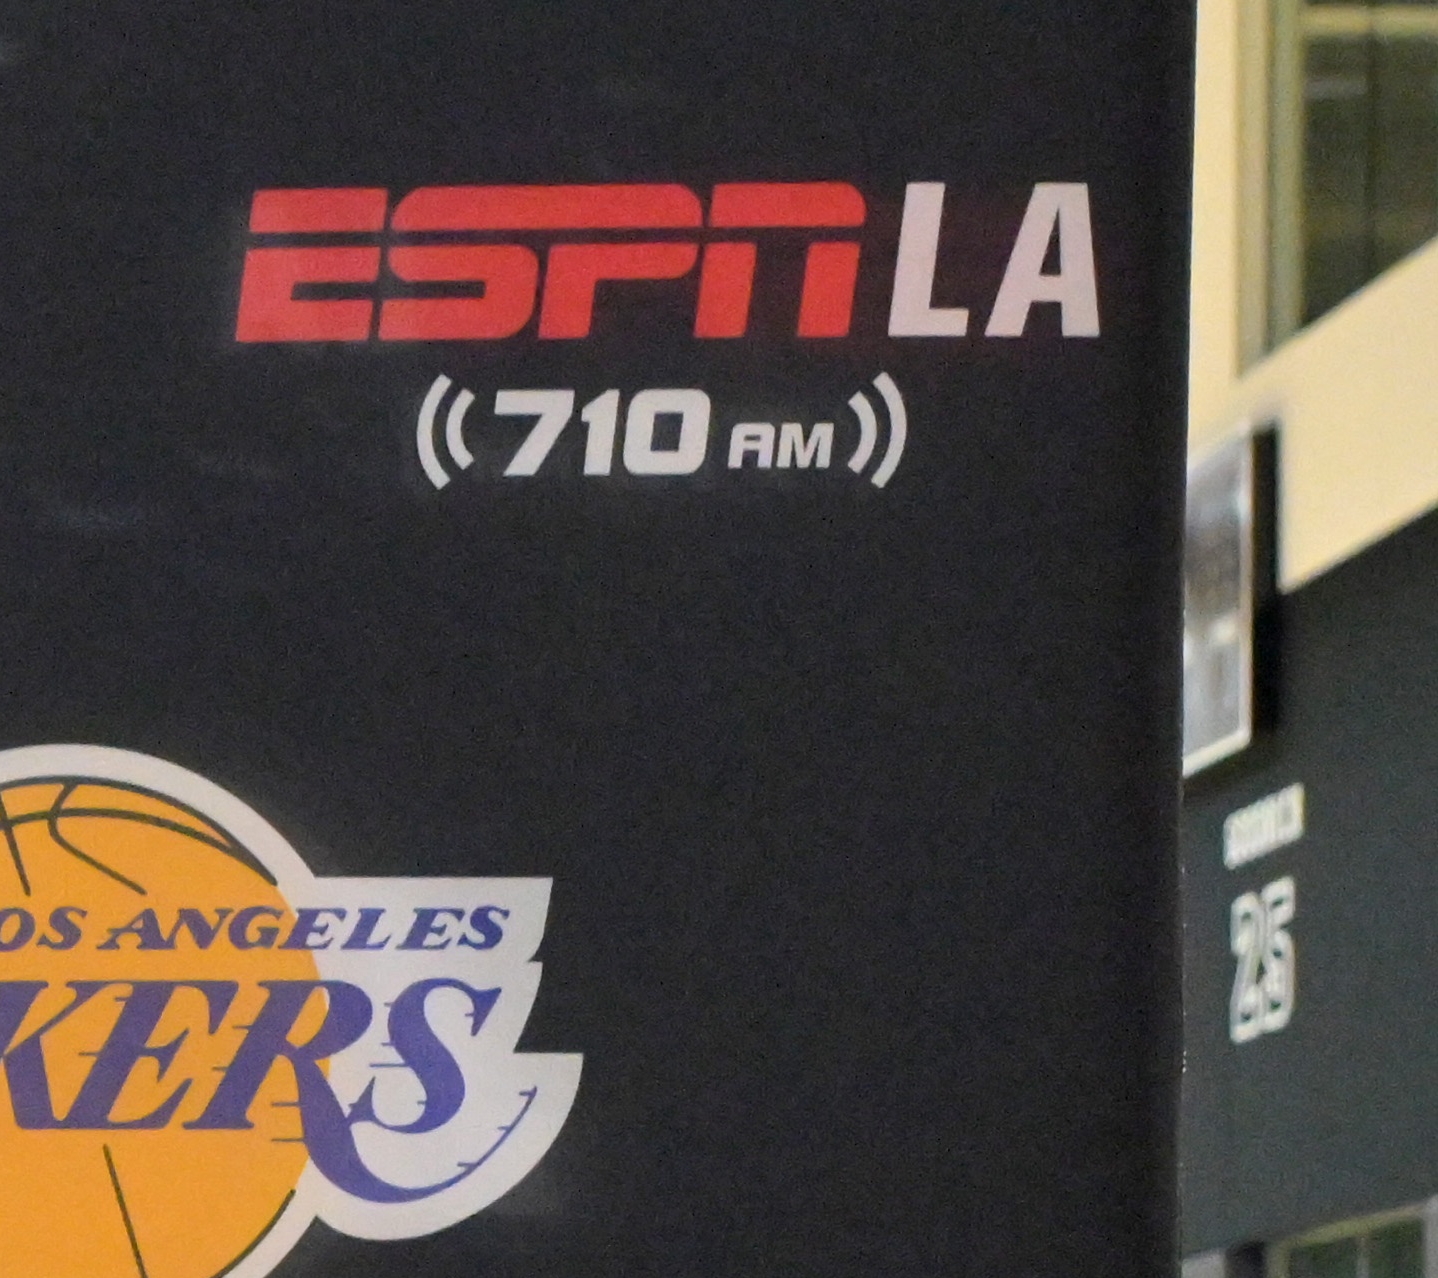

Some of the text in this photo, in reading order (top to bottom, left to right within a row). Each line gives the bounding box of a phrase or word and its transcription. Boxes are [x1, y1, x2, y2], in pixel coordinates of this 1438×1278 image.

[235, 181, 1101, 342] ESPN LA
[493, 388, 835, 478] 710 AM
[96, 904, 511, 953] ANGELES
